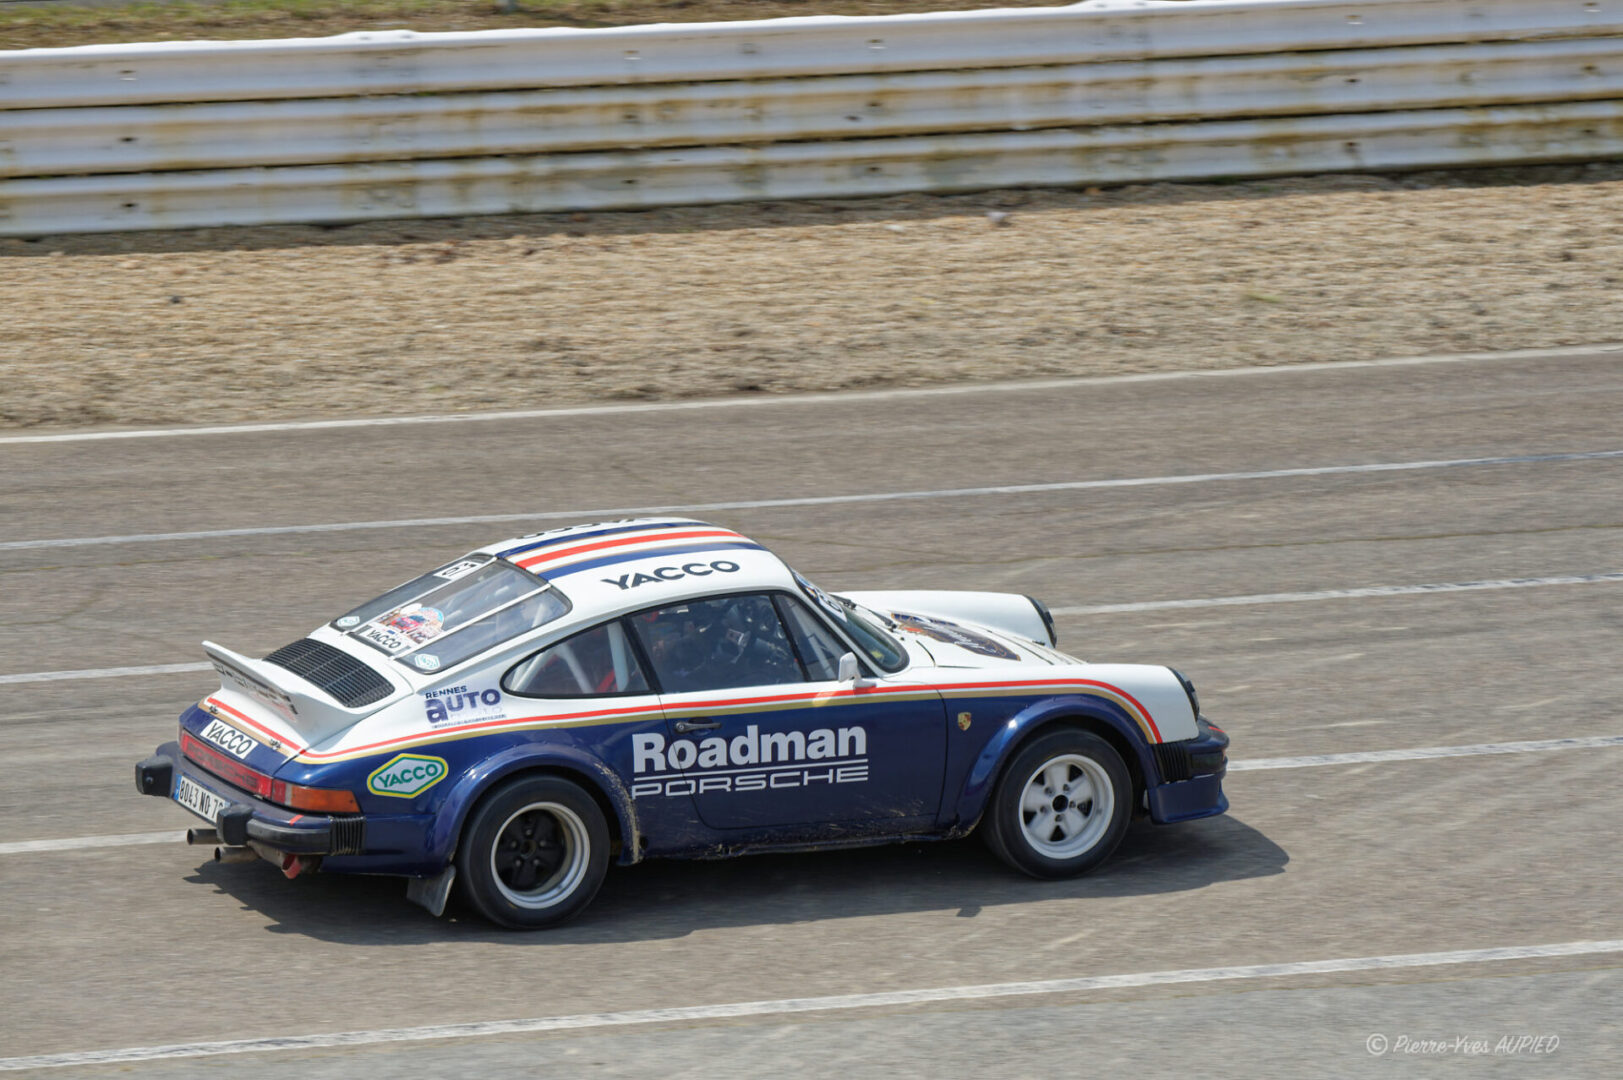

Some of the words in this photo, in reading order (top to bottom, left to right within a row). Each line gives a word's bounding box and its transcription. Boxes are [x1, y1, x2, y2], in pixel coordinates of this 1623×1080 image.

[600, 560, 740, 590] YACCO
[366, 629, 401, 649] YACCO
[425, 685, 467, 699] RENNES
[206, 722, 253, 755] YACCO
[632, 725, 867, 773] Roadman
[378, 763, 438, 788] YACCO
[631, 765, 869, 799] PORSCHE
[180, 780, 199, 808] 8043
